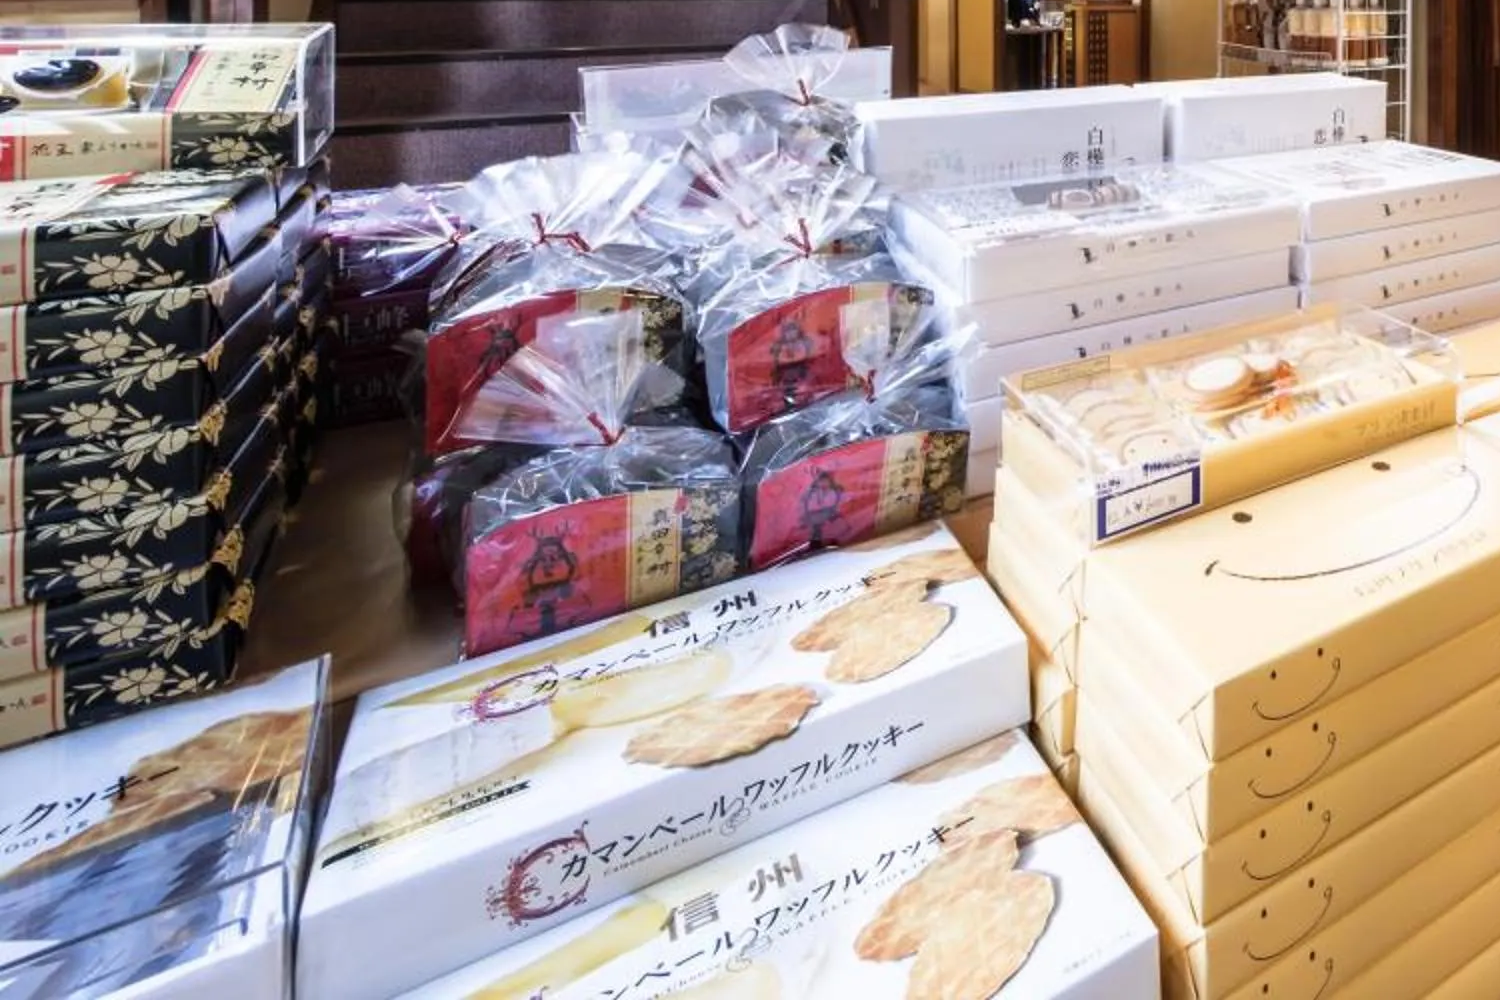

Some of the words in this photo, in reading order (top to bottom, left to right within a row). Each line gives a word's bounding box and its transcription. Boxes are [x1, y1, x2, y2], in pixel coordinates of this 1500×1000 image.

[643, 590, 757, 639] 信州
[0, 766, 180, 836] クッキー
[560, 718, 925, 884] カマンベールワッフルクッキー
[660, 853, 804, 942] 信州
